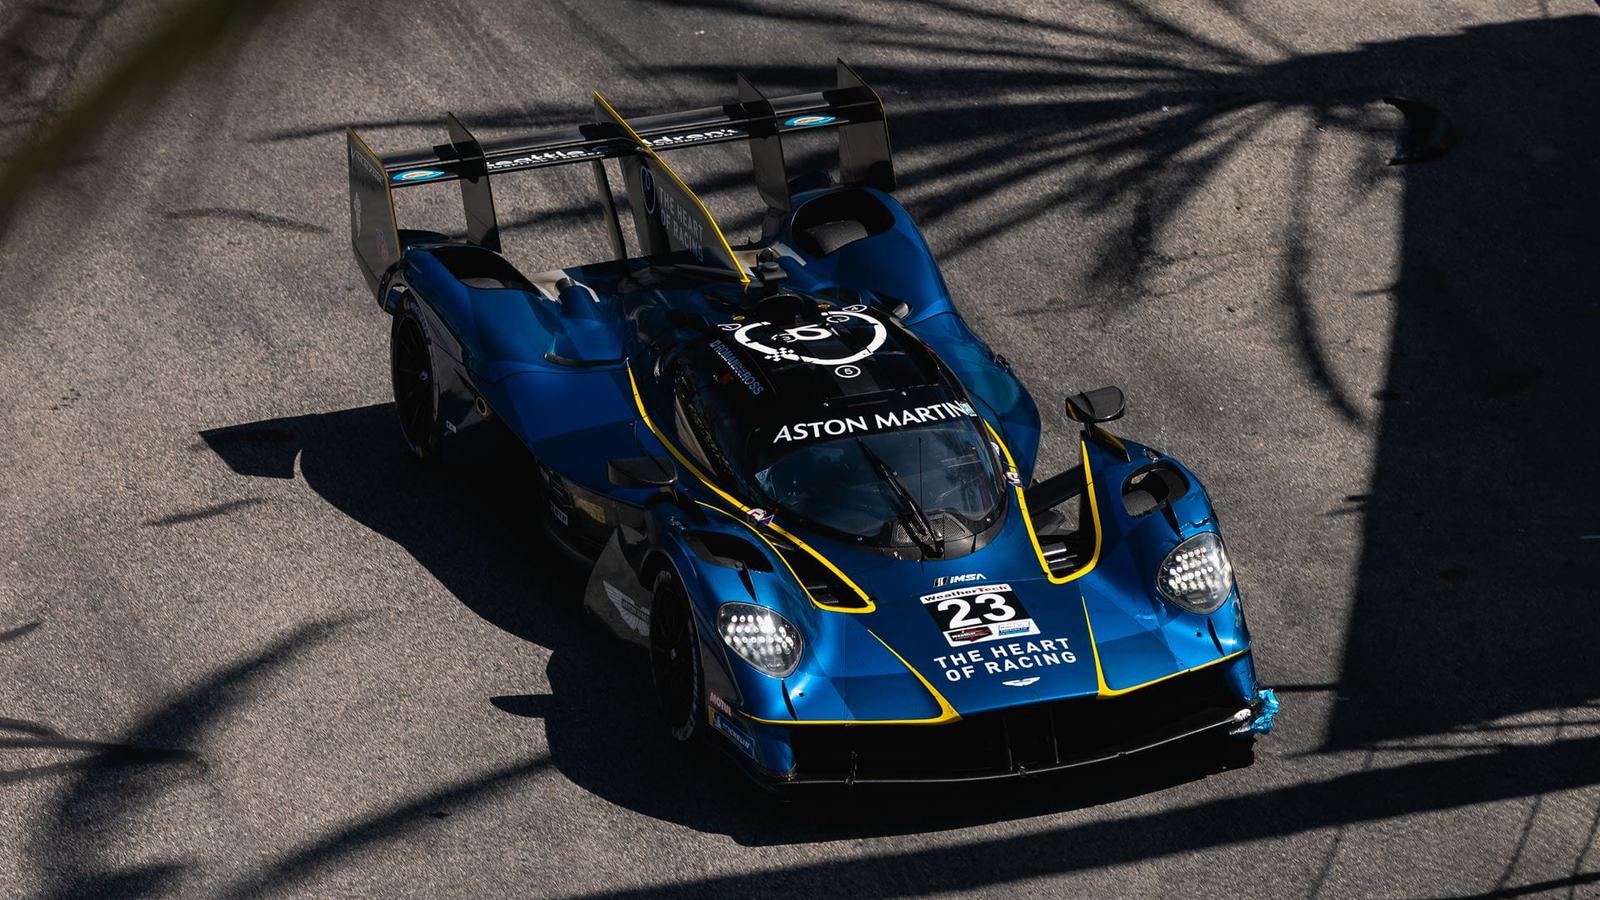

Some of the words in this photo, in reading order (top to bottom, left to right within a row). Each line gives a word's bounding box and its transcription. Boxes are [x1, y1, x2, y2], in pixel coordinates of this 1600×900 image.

[659, 186, 675, 216] THE
[676, 203, 704, 241] HEART
[660, 208, 671, 230] OF
[673, 220, 704, 262] RACING
[742, 371, 764, 395] ROSS
[773, 415, 869, 444] ASTON
[874, 399, 969, 430] MARTIN
[924, 585, 1009, 602] WeatherTech
[949, 573, 987, 584] IMSA
[937, 593, 1017, 630] 23
[933, 649, 985, 669] THE
[990, 637, 1070, 660] HEART
[945, 665, 976, 682] OF
[984, 651, 1077, 675] RACING
[709, 691, 732, 717] MOTUL
